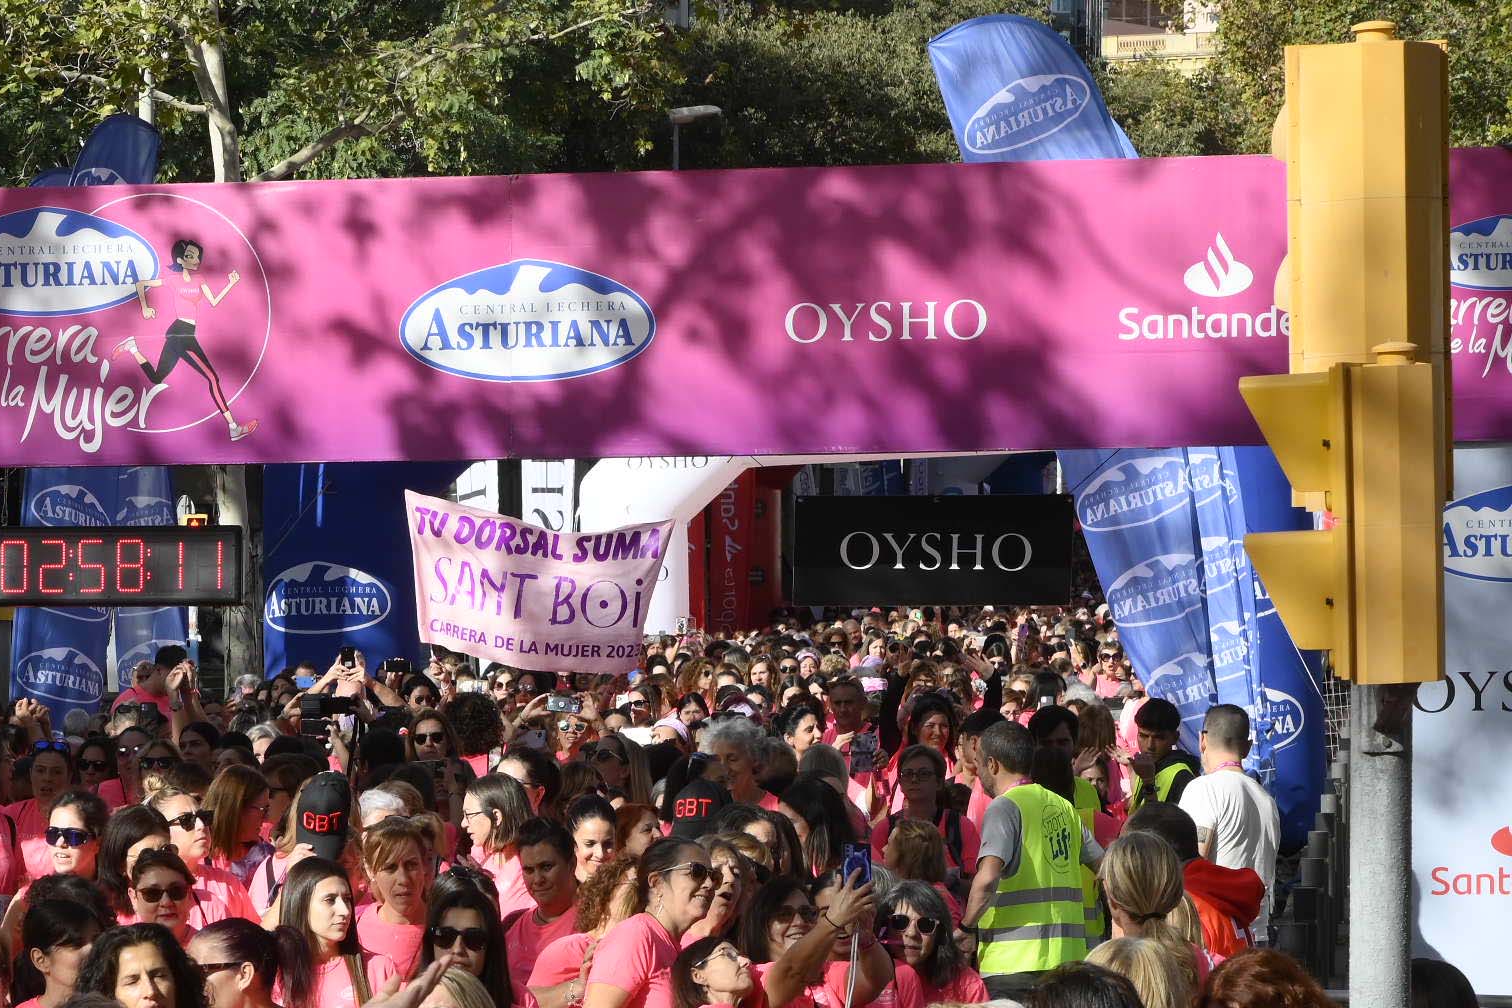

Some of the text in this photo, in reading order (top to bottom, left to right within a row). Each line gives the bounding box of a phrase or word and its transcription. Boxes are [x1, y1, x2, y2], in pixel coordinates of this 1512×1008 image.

[61, 242, 135, 255] LECHERA
[459, 300, 628, 316] CENTRAL LECHERA
[784, 299, 988, 345] OYSHO
[419, 306, 636, 352] ASTURIANA
[1468, 325, 1487, 354] la
[1, 368, 25, 407] la
[20, 359, 169, 453] Mujer
[414, 506, 661, 563] TU DORSAL SUMA
[839, 531, 1034, 572] OYSHO
[0, 539, 224, 594] 02:58:11
[267, 589, 381, 619] ASTURIANA
[429, 556, 540, 621] SANT
[429, 618, 487, 646] CARRERA
[494, 634, 515, 653] DE
[518, 641, 539, 655] LA
[544, 643, 602, 658] MUJER
[24, 662, 99, 698] ASTURIANA
[303, 811, 344, 833] GBT
[674, 797, 712, 818] GBT
